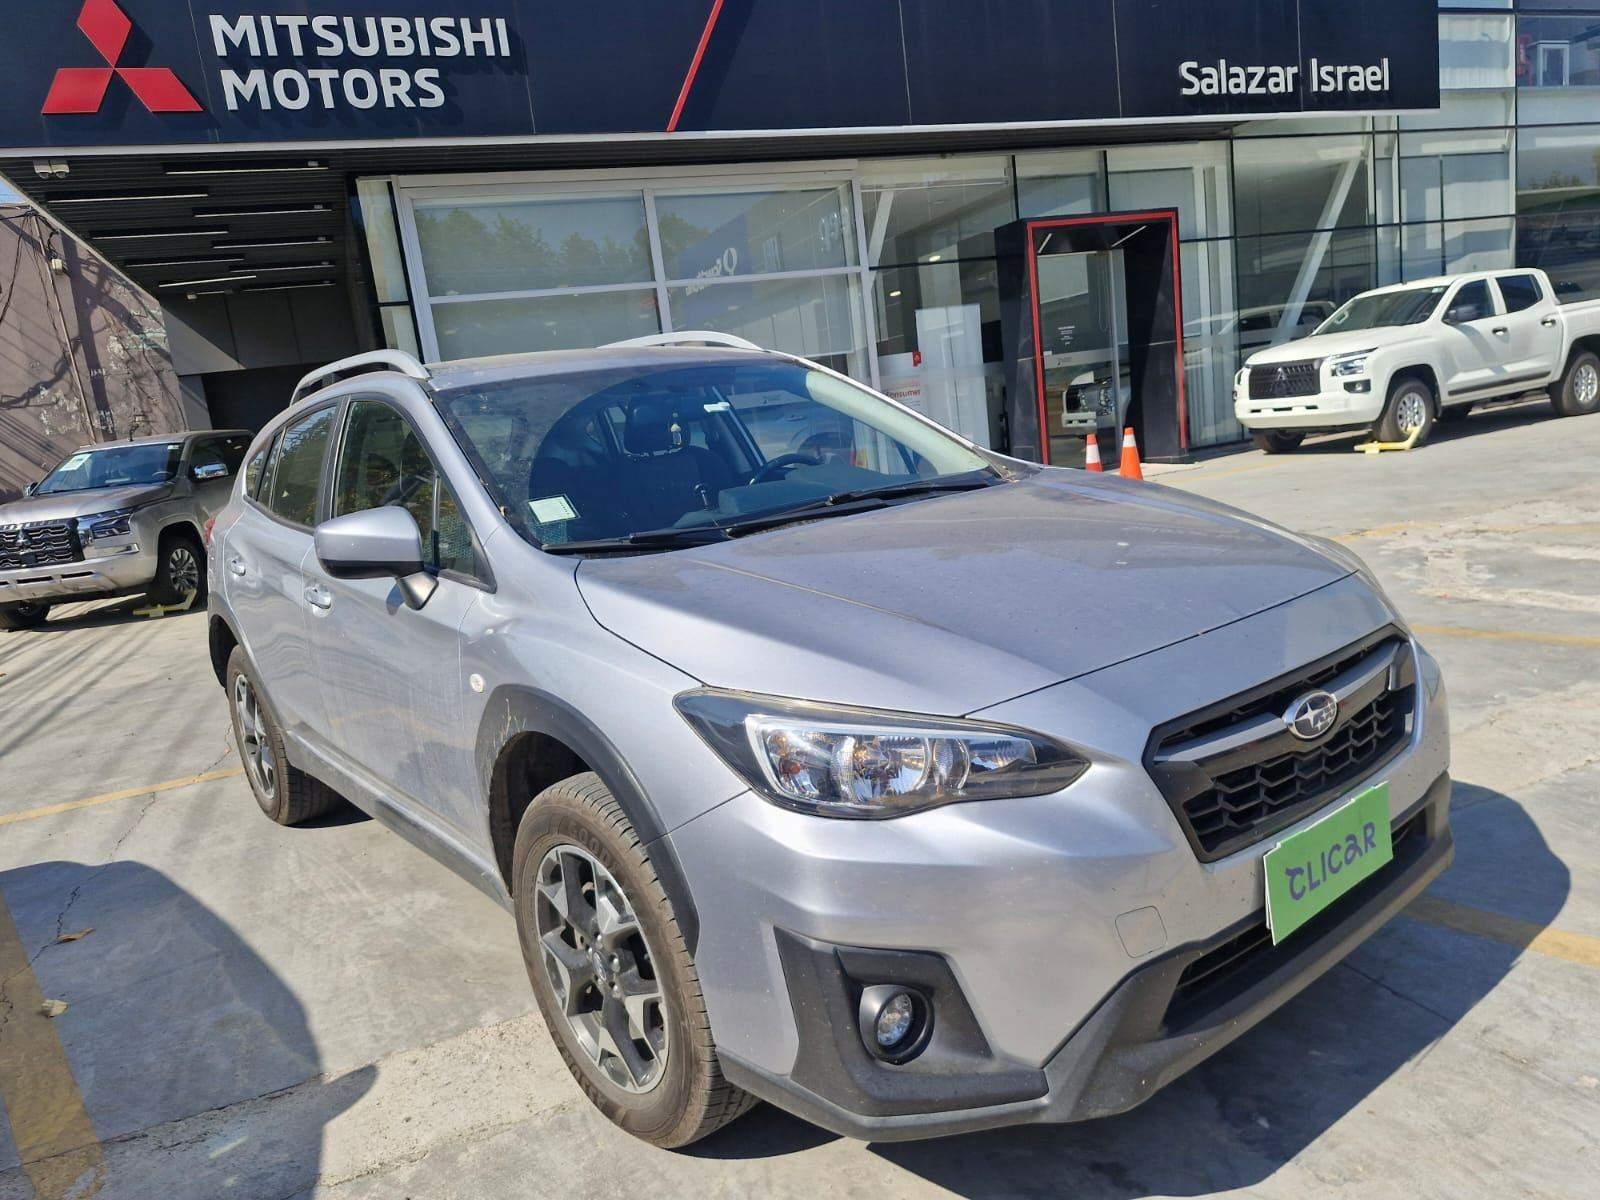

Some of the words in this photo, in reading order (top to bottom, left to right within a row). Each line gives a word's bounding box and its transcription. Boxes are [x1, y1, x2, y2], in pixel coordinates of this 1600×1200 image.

[209, 15, 510, 56] MITSUBISHI
[220, 68, 445, 110] MOTORS
[1179, 59, 1298, 95] Salazar
[1310, 57, 1390, 92] Israel
